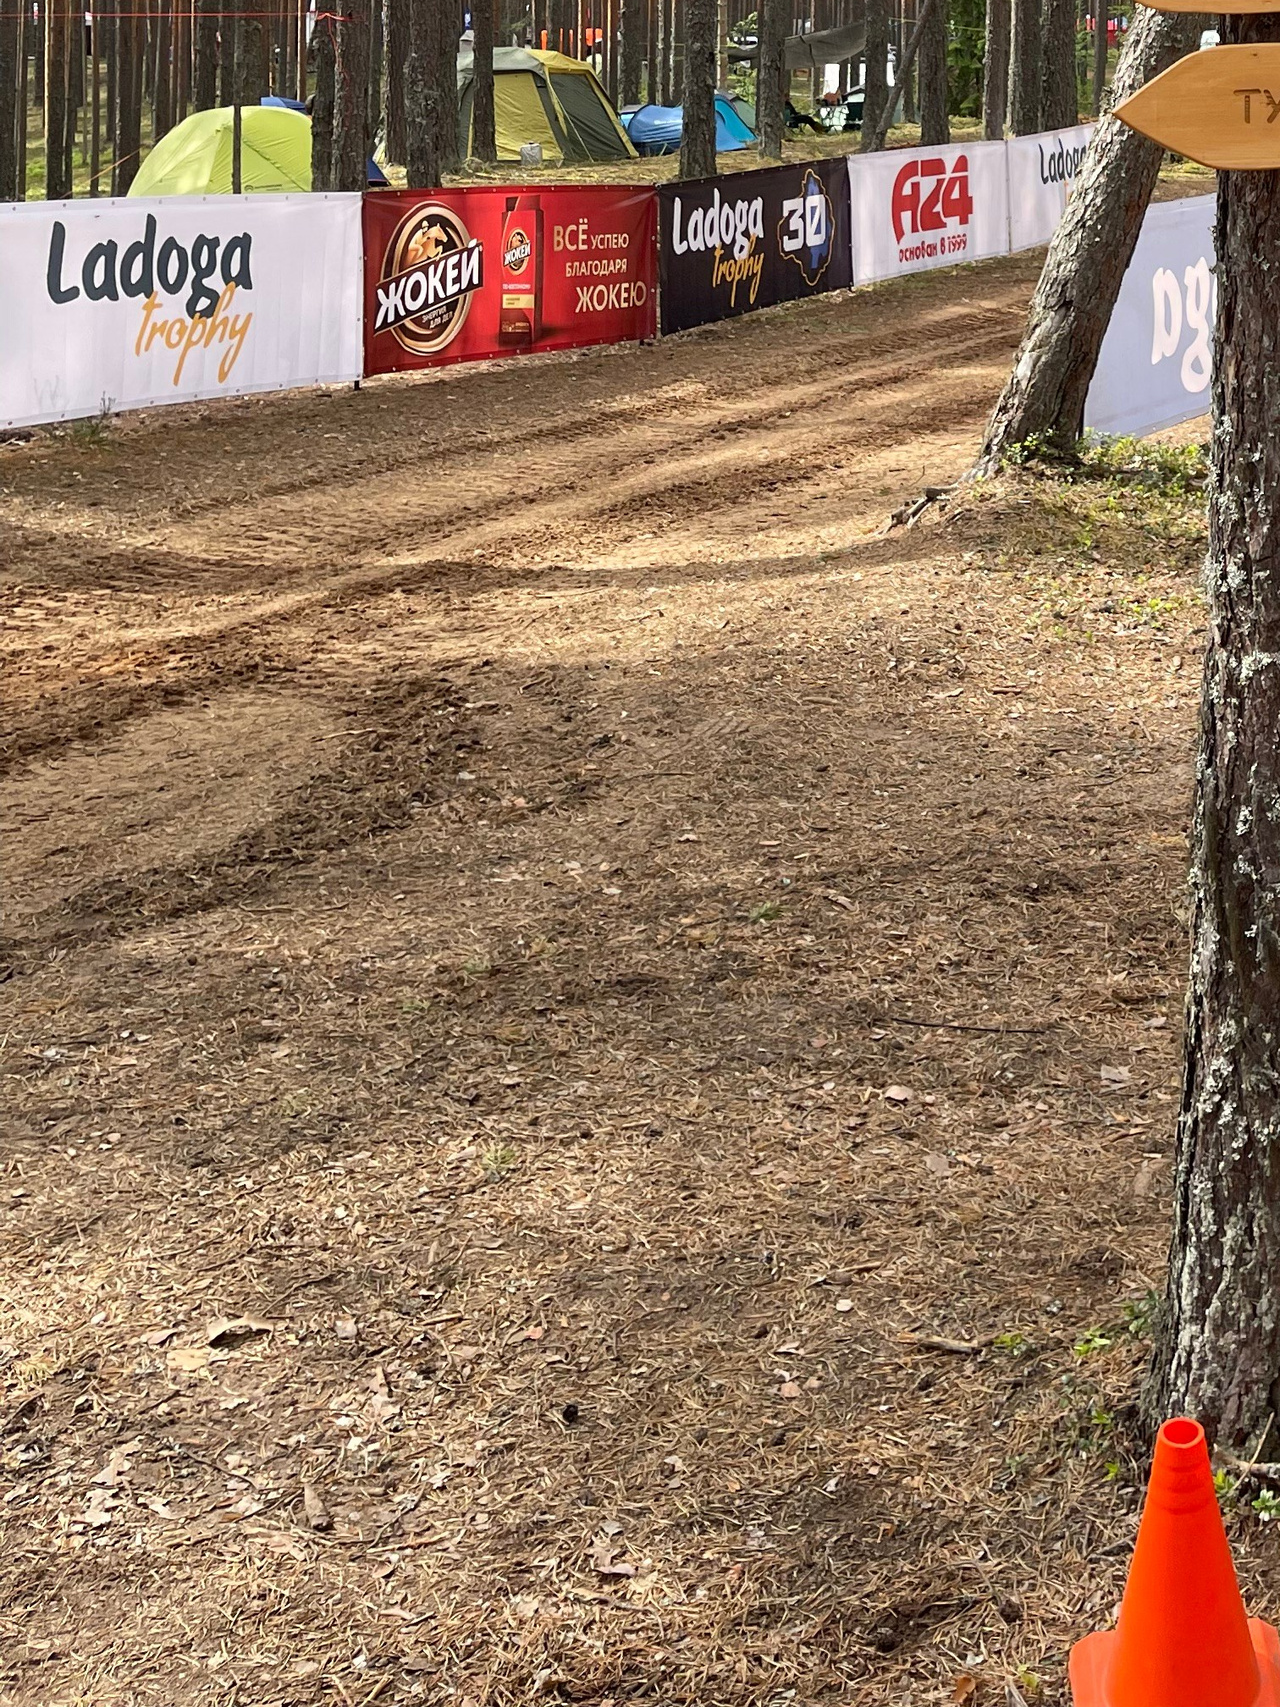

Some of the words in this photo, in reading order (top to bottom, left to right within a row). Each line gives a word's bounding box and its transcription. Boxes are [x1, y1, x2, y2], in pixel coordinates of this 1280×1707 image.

[553, 218, 588, 252] ВСЁ
[590, 233, 629, 250] УСПЕЮ
[672, 187, 764, 261] Ladoga
[783, 194, 826, 252] 30
[47, 213, 253, 320] Ladoga
[504, 240, 531, 266] ЖОКЕЙ
[565, 258, 628, 278] БЛАГОДАРЯ
[374, 238, 480, 330] ЖОКЕЙ
[575, 280, 647, 313] ЖОКЕЮ
[135, 281, 253, 386] trophy
